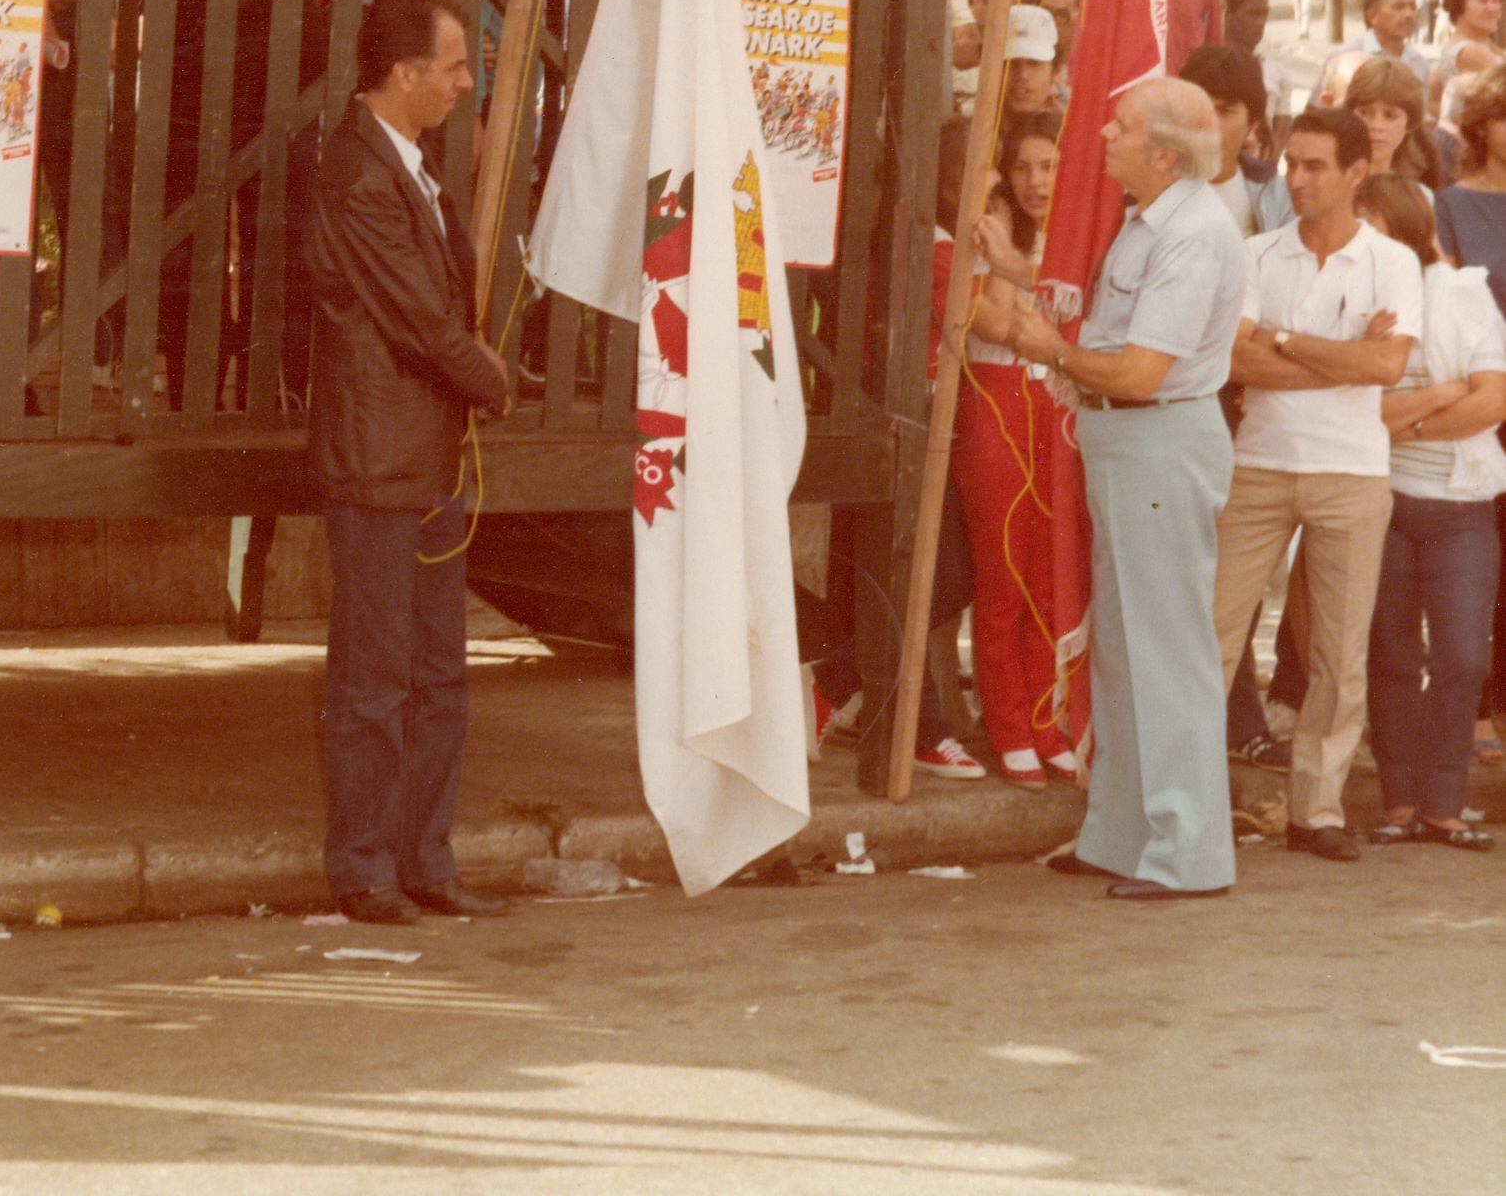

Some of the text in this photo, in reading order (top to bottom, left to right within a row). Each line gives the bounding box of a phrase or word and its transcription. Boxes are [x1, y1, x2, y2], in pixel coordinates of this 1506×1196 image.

[741, 3, 835, 35] SEAR DE
[746, 30, 824, 60] NARK
